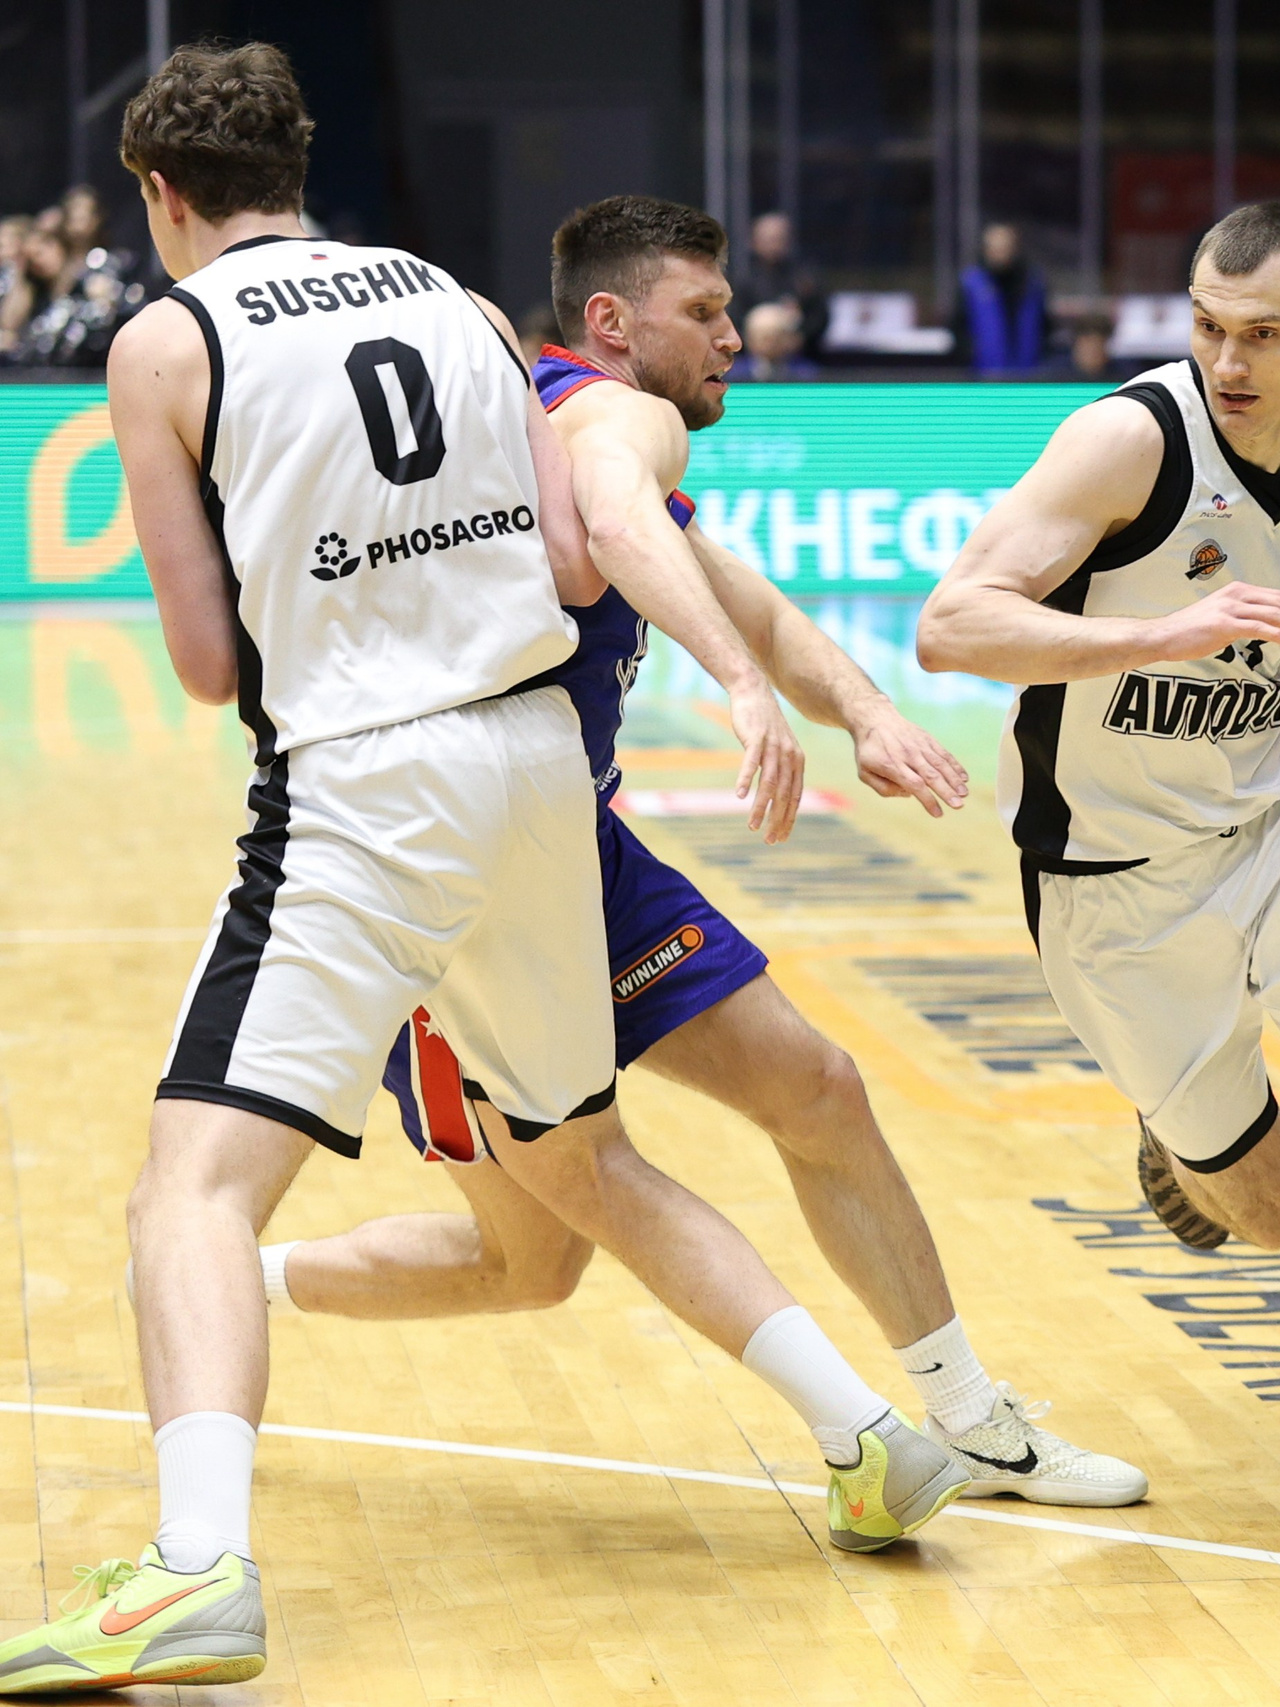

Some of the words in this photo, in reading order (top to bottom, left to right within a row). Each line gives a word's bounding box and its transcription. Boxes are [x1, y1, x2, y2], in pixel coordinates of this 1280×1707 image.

[235, 258, 448, 326] SUSCHIK
[344, 336, 447, 486] 0
[367, 504, 535, 570] PHOSAGRO
[616, 939, 684, 998] WINLINE
